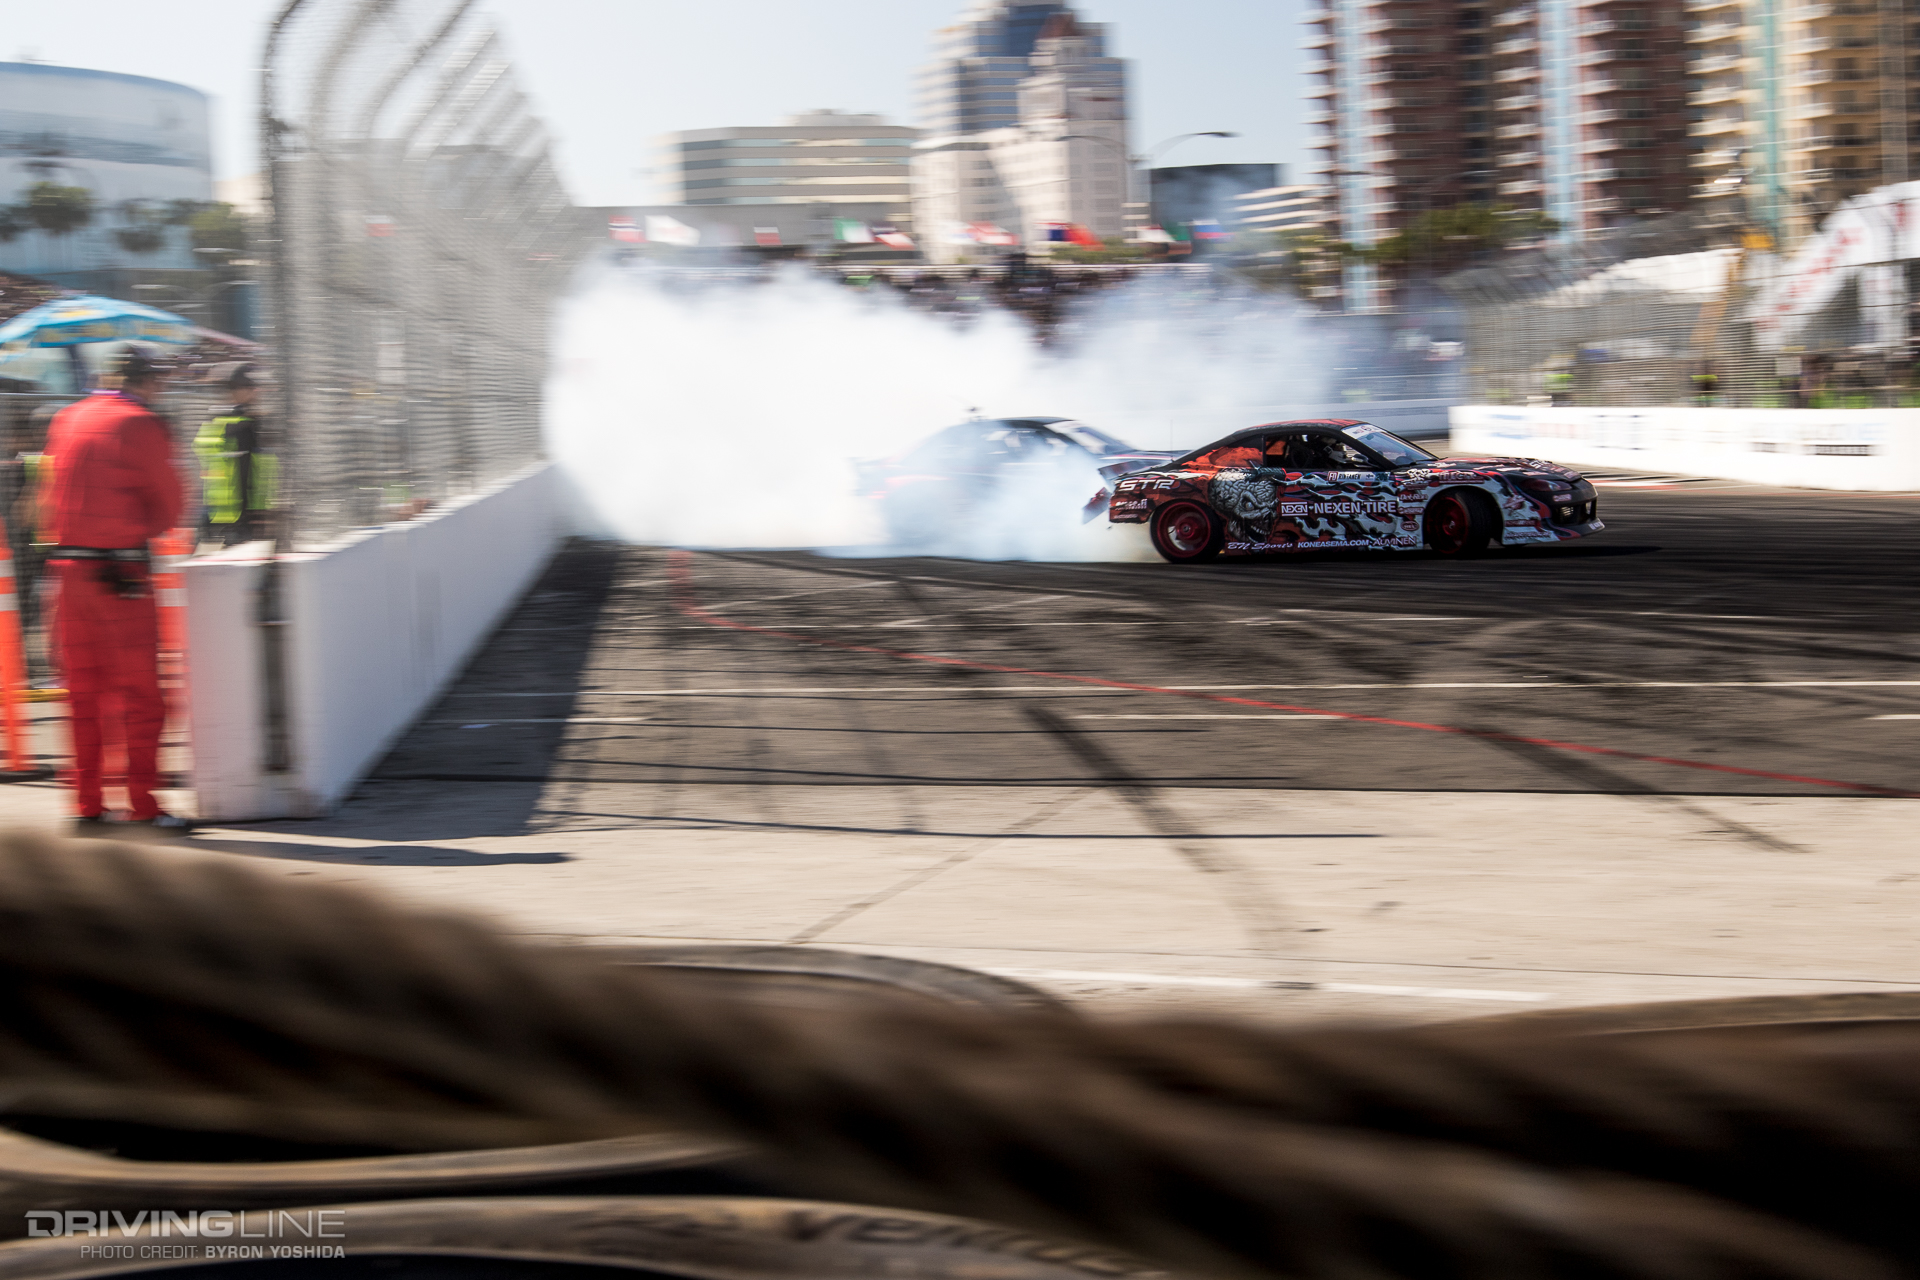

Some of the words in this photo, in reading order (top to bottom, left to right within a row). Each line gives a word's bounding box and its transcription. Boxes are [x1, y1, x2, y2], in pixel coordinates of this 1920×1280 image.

[1281, 504, 1308, 513] NEXEN
[1314, 502, 1361, 514] NEXEN
[1363, 501, 1397, 513] TIRE
